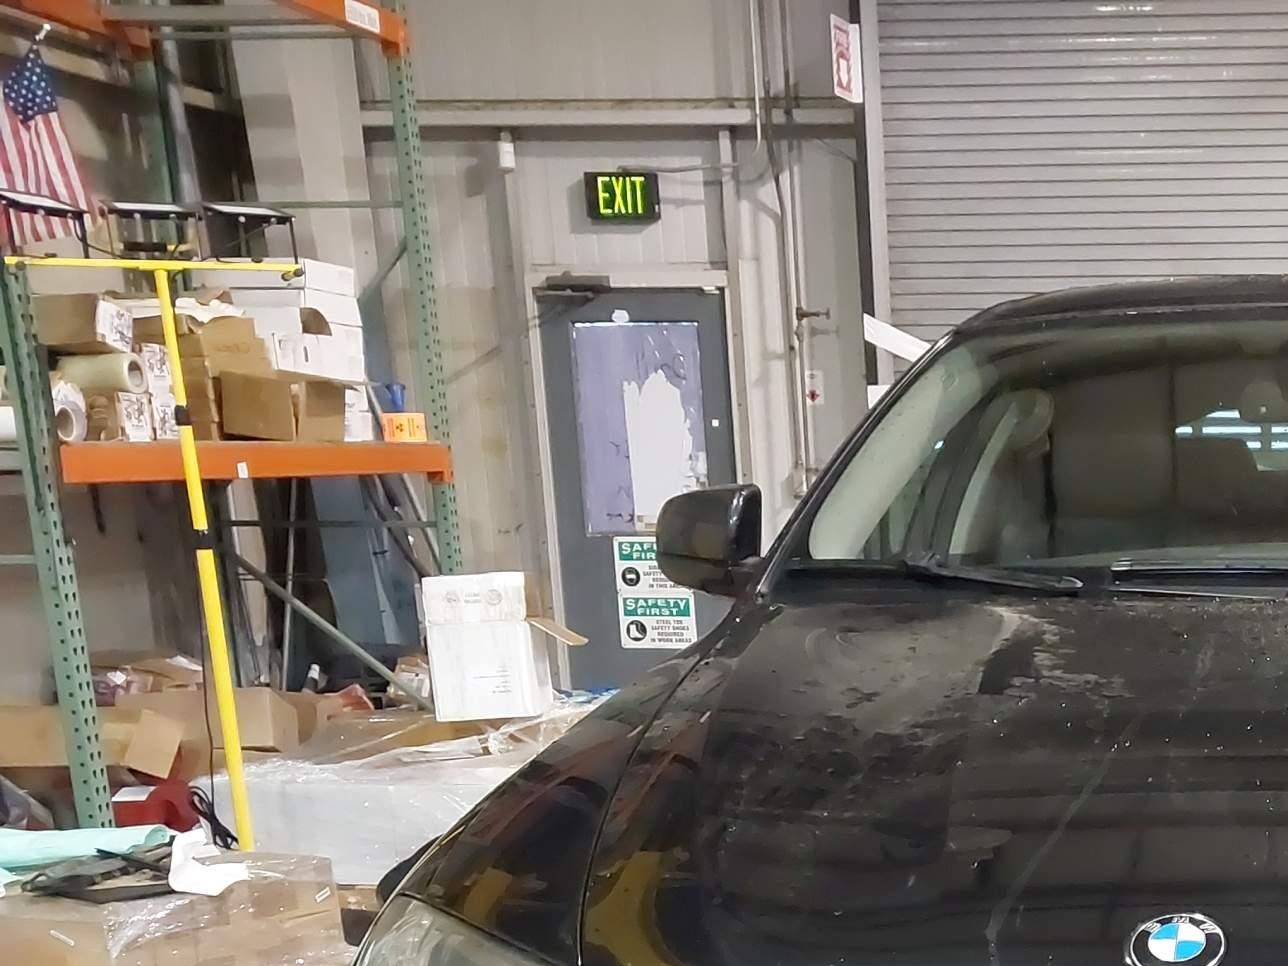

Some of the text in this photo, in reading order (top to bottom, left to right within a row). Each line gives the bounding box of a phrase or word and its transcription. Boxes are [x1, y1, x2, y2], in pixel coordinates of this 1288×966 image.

[597, 176, 645, 214] EXIT
[626, 598, 687, 610] SAFETY
[637, 608, 679, 616] FIRST
[1144, 917, 1219, 933] BMW
